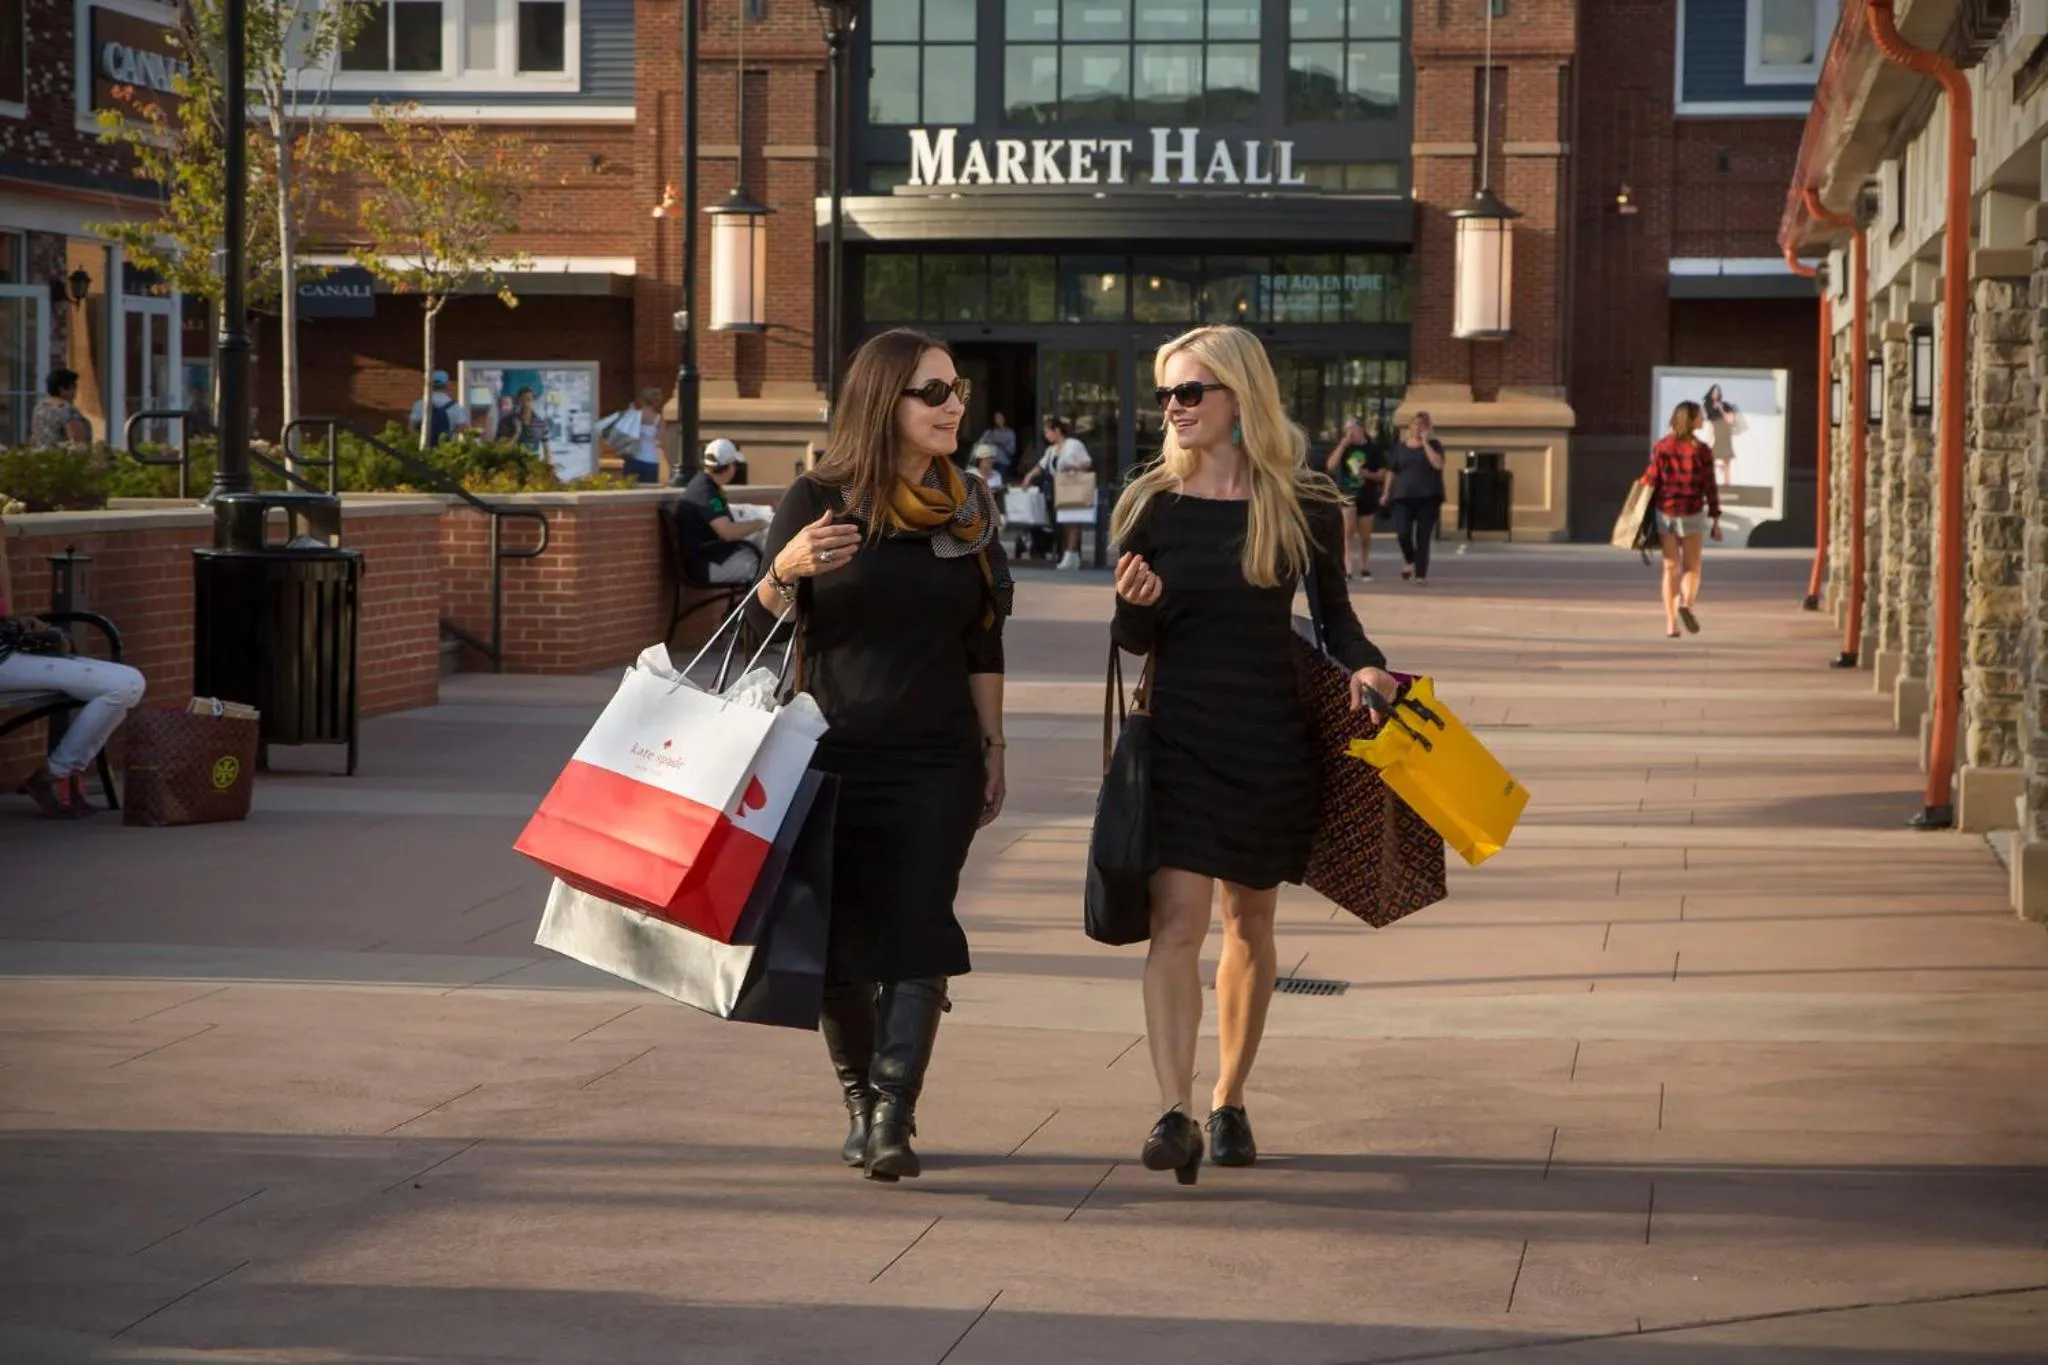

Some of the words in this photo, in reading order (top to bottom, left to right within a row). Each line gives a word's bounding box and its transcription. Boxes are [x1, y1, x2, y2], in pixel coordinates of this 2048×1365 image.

[908, 128, 1133, 185] MARKET
[1149, 127, 1306, 185] HALL
[299, 284, 371, 297] CANALI
